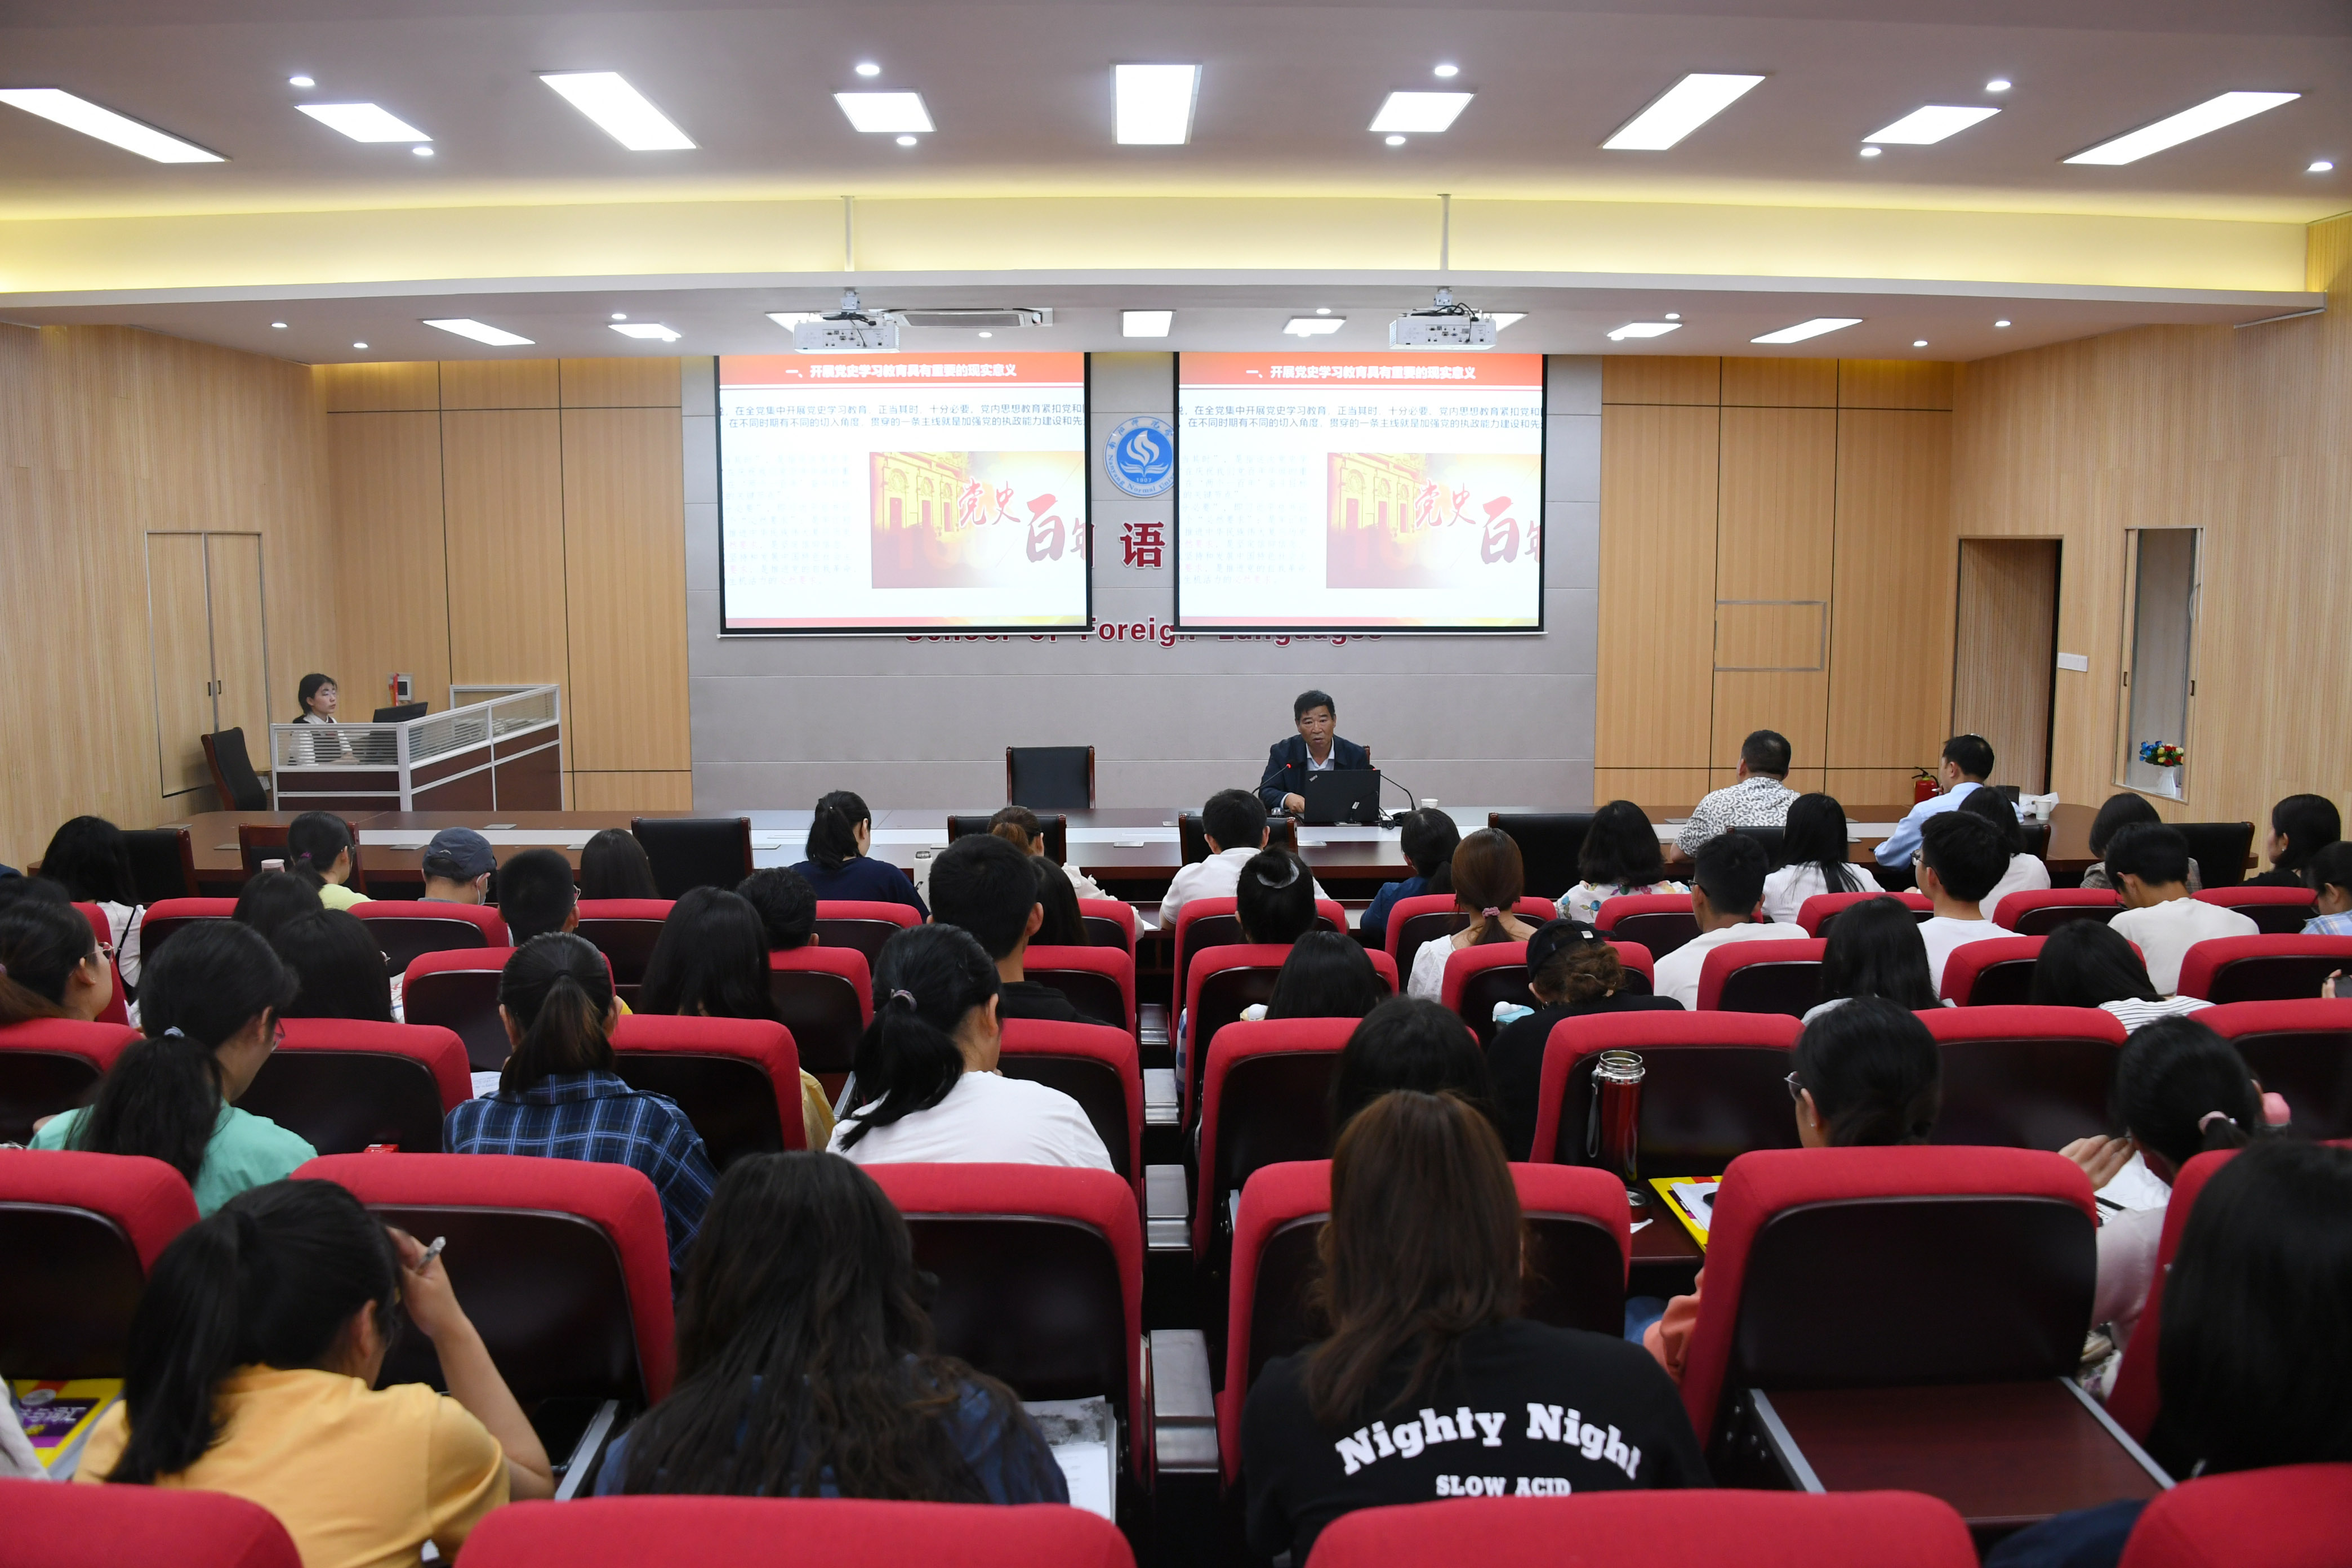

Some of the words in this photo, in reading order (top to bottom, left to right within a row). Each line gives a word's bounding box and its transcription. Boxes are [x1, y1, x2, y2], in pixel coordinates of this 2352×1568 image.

[786, 364, 1017, 378] 一、开展党史学习教育具有重要的现实意义
[1245, 366, 1476, 380] 一、开展党史学习教育具有重要的现实意义
[1080, 617, 1196, 647] oreig
[1335, 1406, 1507, 1476] Nighty
[1436, 1474, 1507, 1497] SLOW
[1514, 1476, 1572, 1497] ACID
